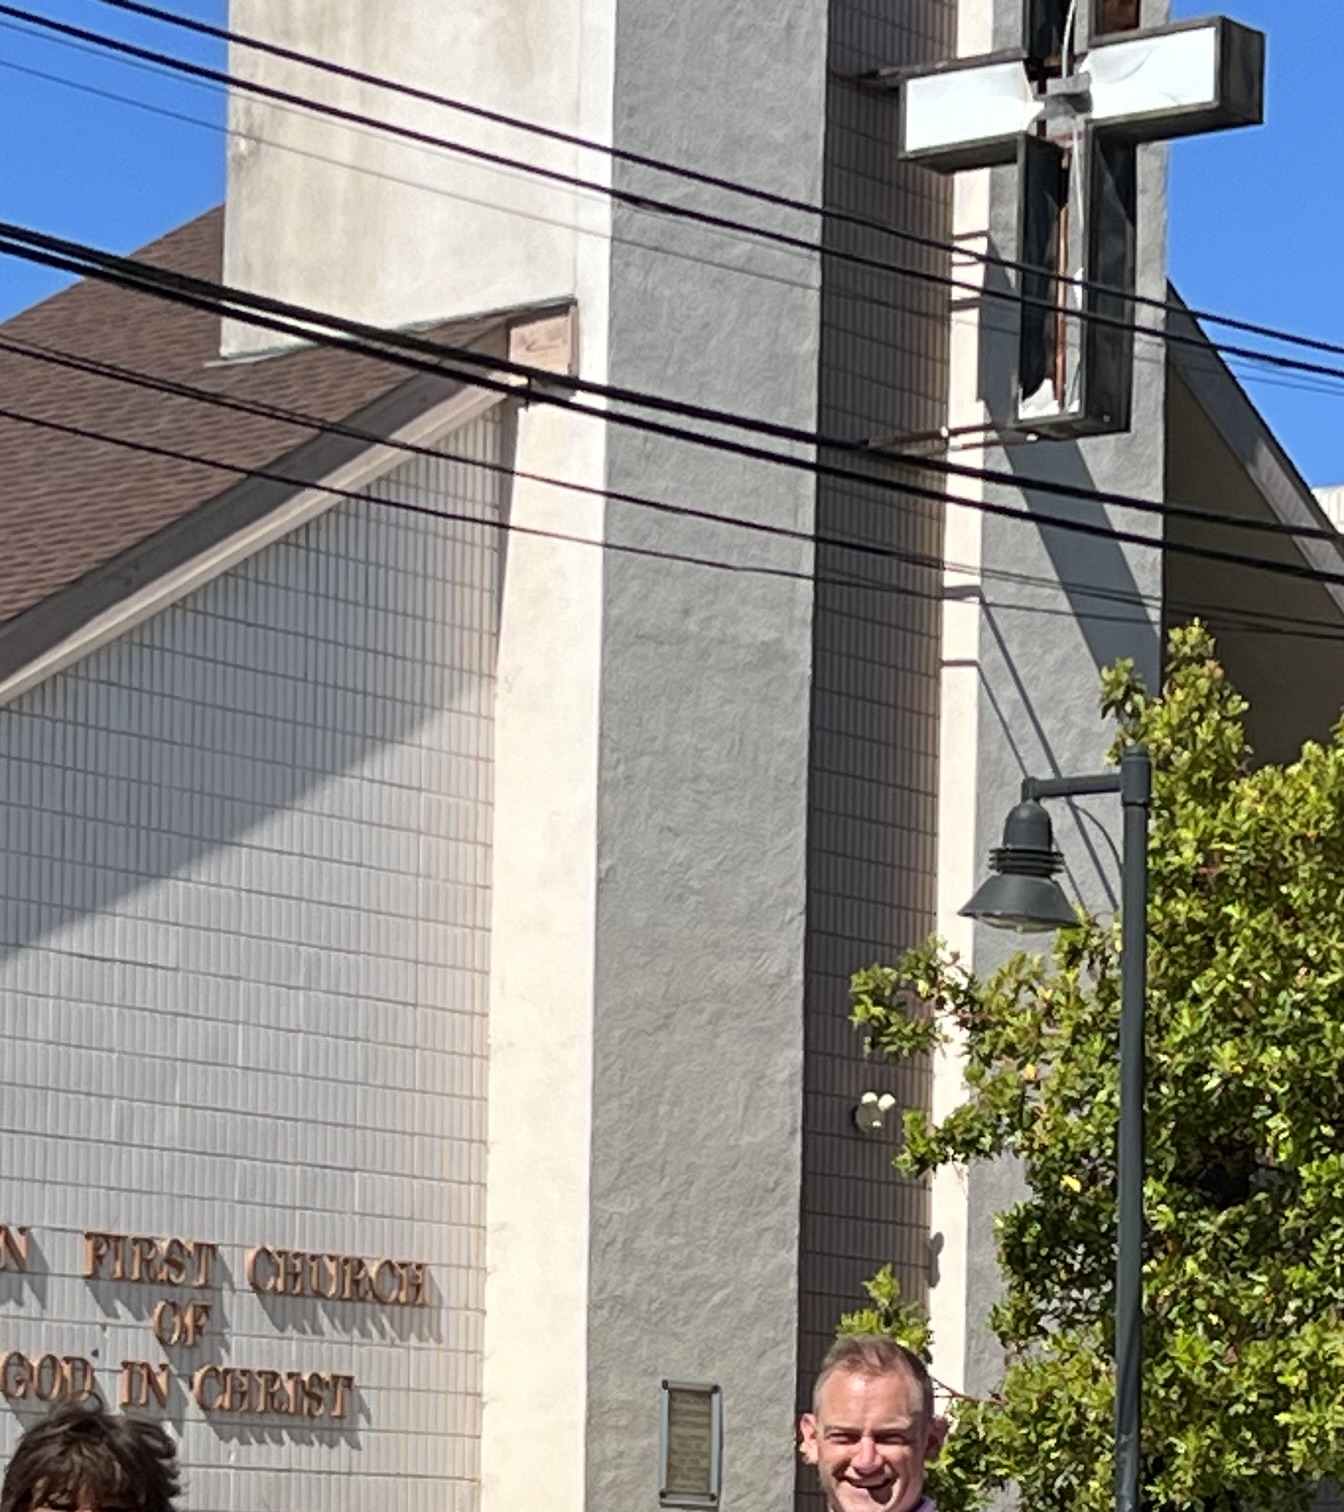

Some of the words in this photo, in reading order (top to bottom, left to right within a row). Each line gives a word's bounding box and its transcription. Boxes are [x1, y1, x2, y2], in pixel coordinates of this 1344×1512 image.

[84, 1231, 218, 1288] FIRST
[245, 1246, 428, 1307] CHURCH
[152, 1299, 212, 1347] OF
[120, 1361, 170, 1407] IN
[191, 1364, 355, 1418] CHRIST
